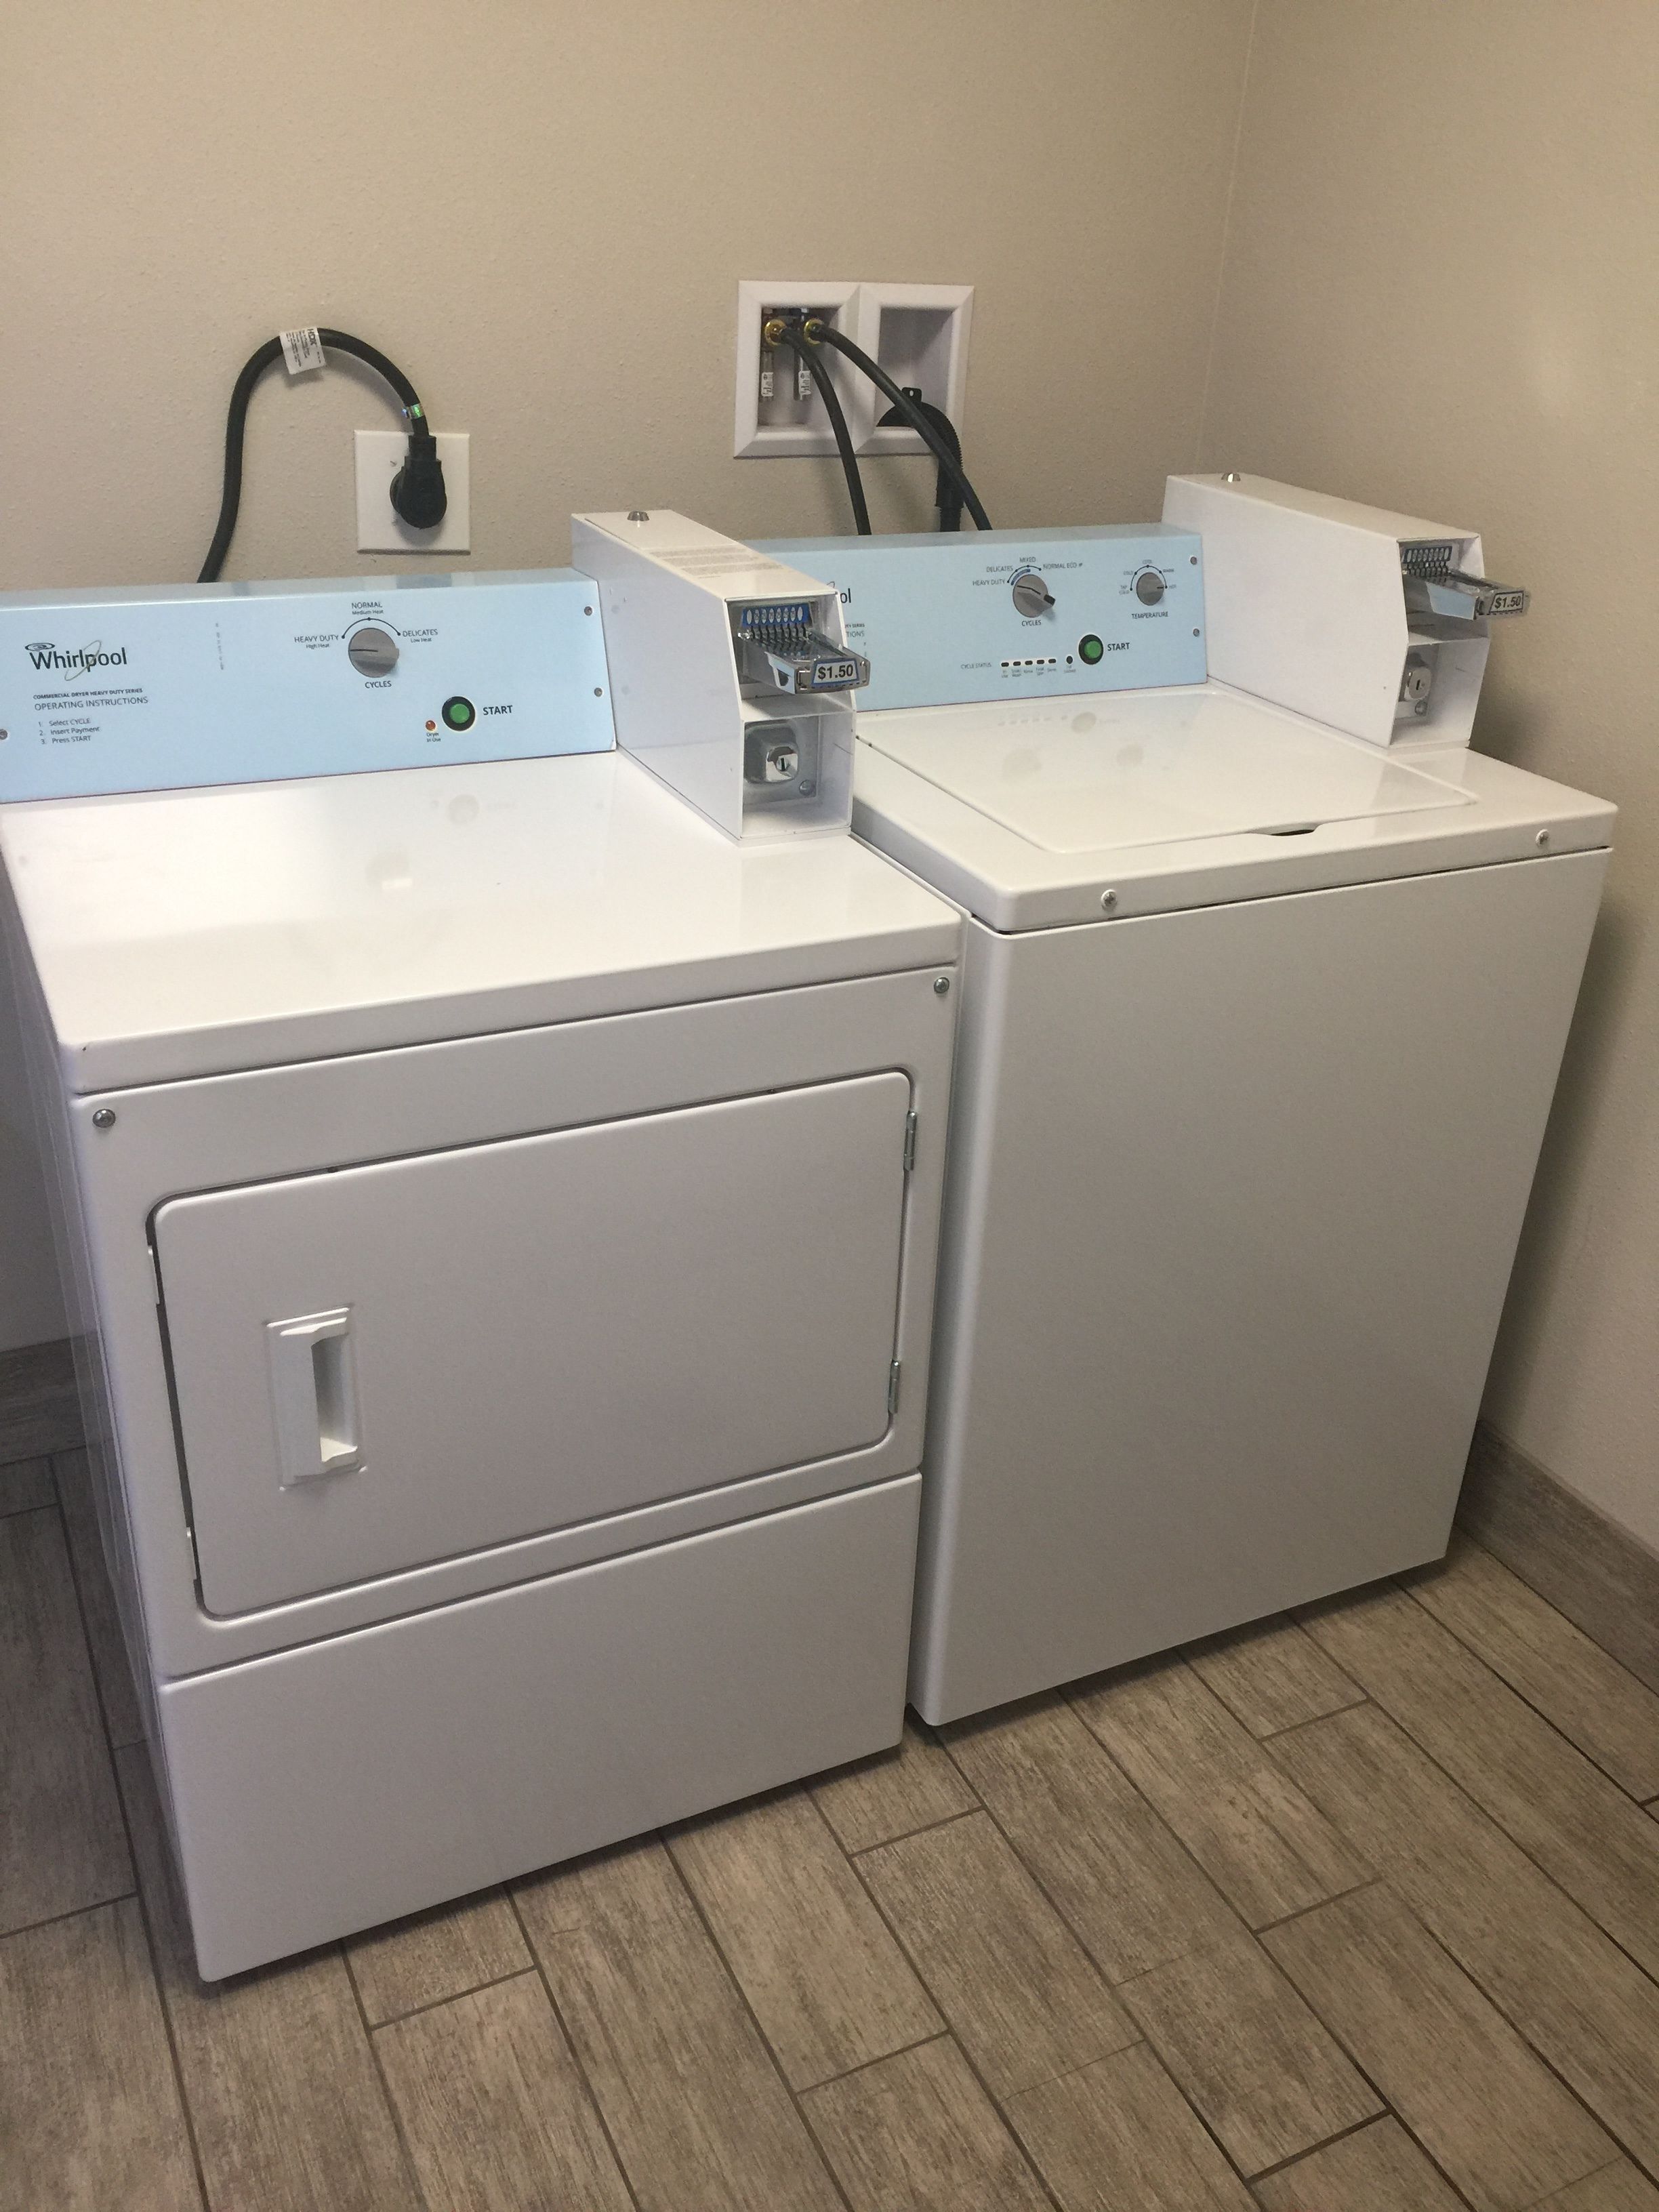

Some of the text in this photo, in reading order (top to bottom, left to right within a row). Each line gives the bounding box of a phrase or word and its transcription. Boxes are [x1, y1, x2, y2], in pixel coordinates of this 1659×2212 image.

[1495, 596, 1521, 609] $1.50
[403, 629, 438, 637] DELICATES
[1107, 642, 1130, 651] START
[29, 647, 127, 672] Whirlpool
[817, 664, 854, 680] $1.50
[365, 680, 392, 689] CYCLES
[35, 697, 148, 711] OPERATING INSTRUCTIONS
[483, 705, 513, 716] START
[70, 726, 100, 735] Payment
